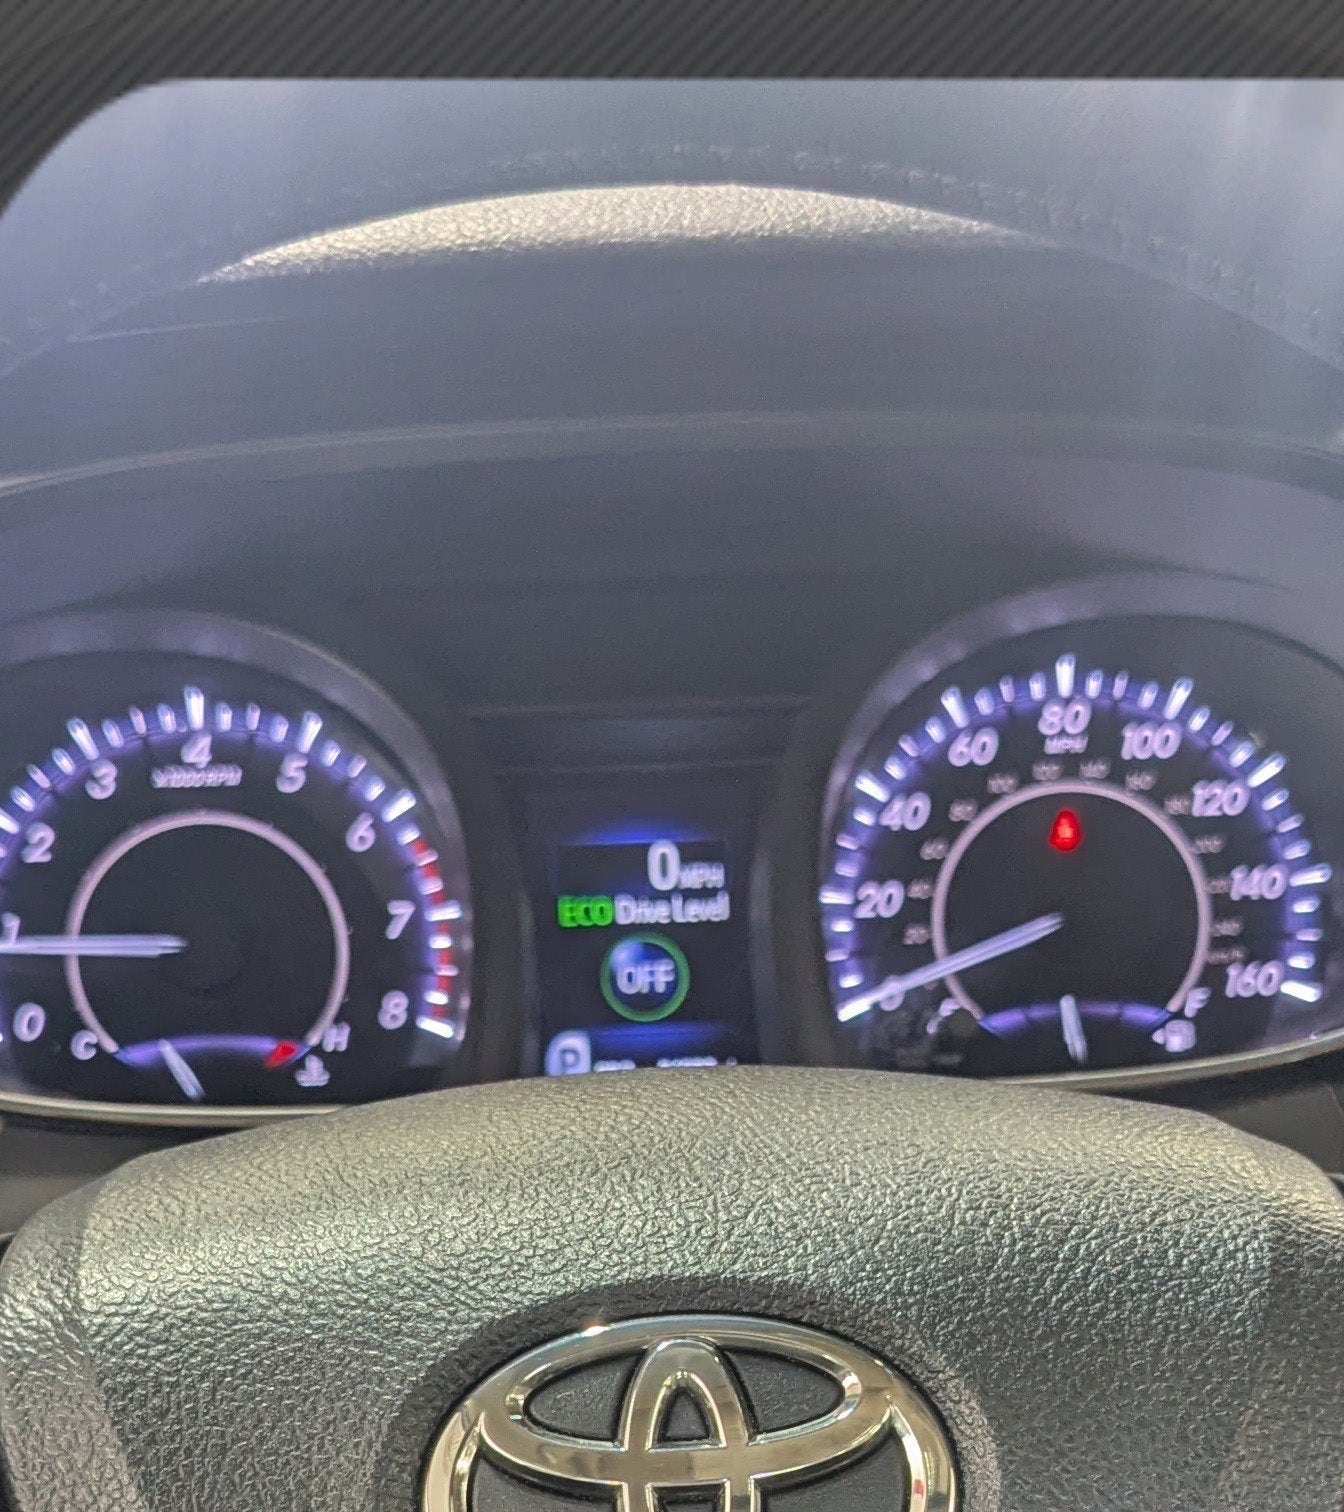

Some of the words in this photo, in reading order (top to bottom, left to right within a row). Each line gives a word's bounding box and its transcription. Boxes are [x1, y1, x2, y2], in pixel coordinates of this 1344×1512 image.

[1038, 698, 1092, 736] 80
[181, 731, 213, 769] 4
[948, 727, 1000, 767] 60
[1121, 721, 1182, 761] 100
[85, 761, 118, 800] 3
[277, 753, 309, 794] 5
[878, 791, 932, 831] 40
[1191, 779, 1250, 817] 120
[22, 823, 56, 864] 2
[346, 813, 377, 853] 6
[647, 840, 680, 890] 0
[1229, 863, 1288, 900] 140
[557, 894, 613, 927] ECO
[613, 894, 671, 925] Drive
[671, 890, 730, 923] Level
[857, 880, 905, 919] 20
[386, 899, 416, 940] 7
[616, 958, 676, 994] OFF
[1225, 960, 1285, 999] 160
[13, 1001, 46, 1043] 0
[378, 990, 410, 1031] 8
[70, 1029, 98, 1061] C
